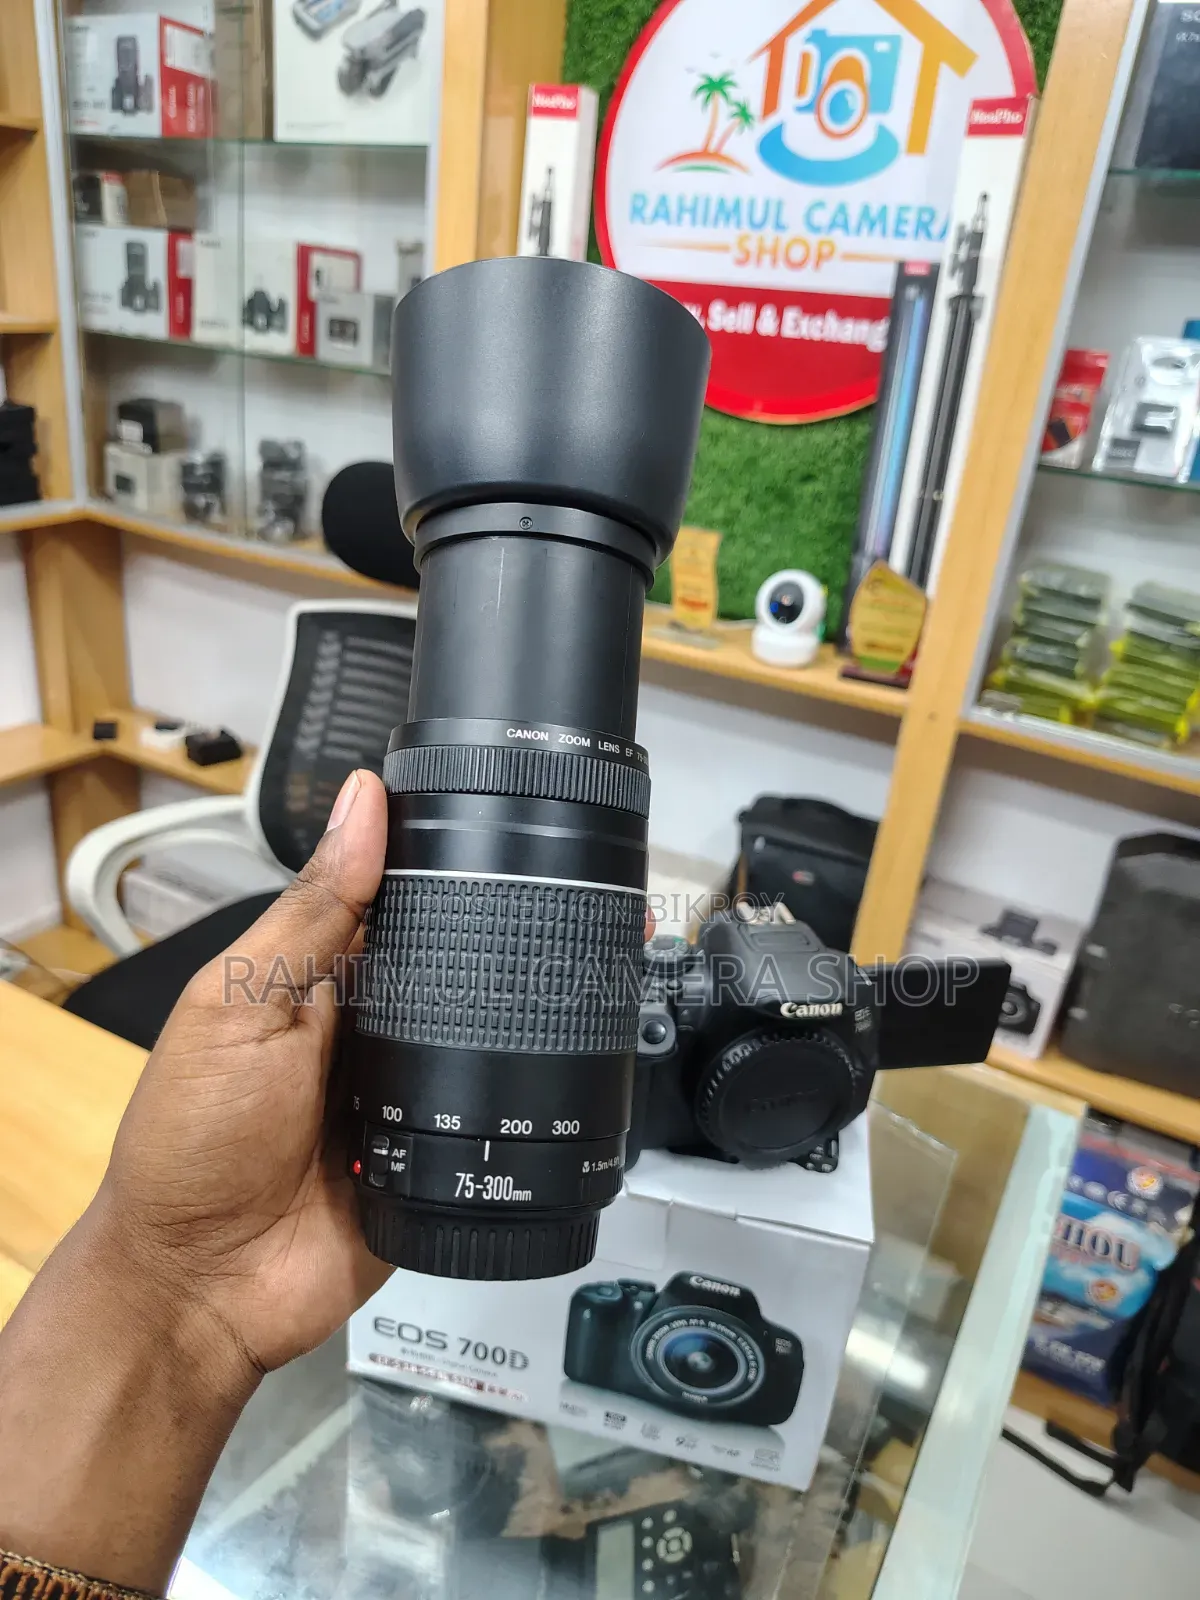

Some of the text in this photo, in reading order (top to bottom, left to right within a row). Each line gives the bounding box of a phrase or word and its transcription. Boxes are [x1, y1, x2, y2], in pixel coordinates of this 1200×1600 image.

[629, 193, 789, 233] RAHIMUL
[733, 234, 837, 271] SHOP
[707, 298, 757, 335] Sell
[756, 301, 779, 337] &
[781, 303, 891, 353] Exchang
[507, 728, 549, 741] CANON
[558, 733, 590, 747] ZOOM
[598, 740, 620, 754] LENS
[625, 747, 634, 757] EF
[780, 1001, 843, 1018] Canon
[382, 1105, 403, 1122] 100
[434, 1113, 461, 1130] 135
[500, 1118, 533, 1135] 200
[552, 1120, 580, 1135] 300
[390, 1161, 406, 1173] MF
[391, 1148, 407, 1159] AF
[454, 1172, 532, 1202] 75-300mm
[689, 1275, 741, 1297] Canon
[373, 1315, 448, 1350] EOS
[457, 1336, 530, 1371] 700D
